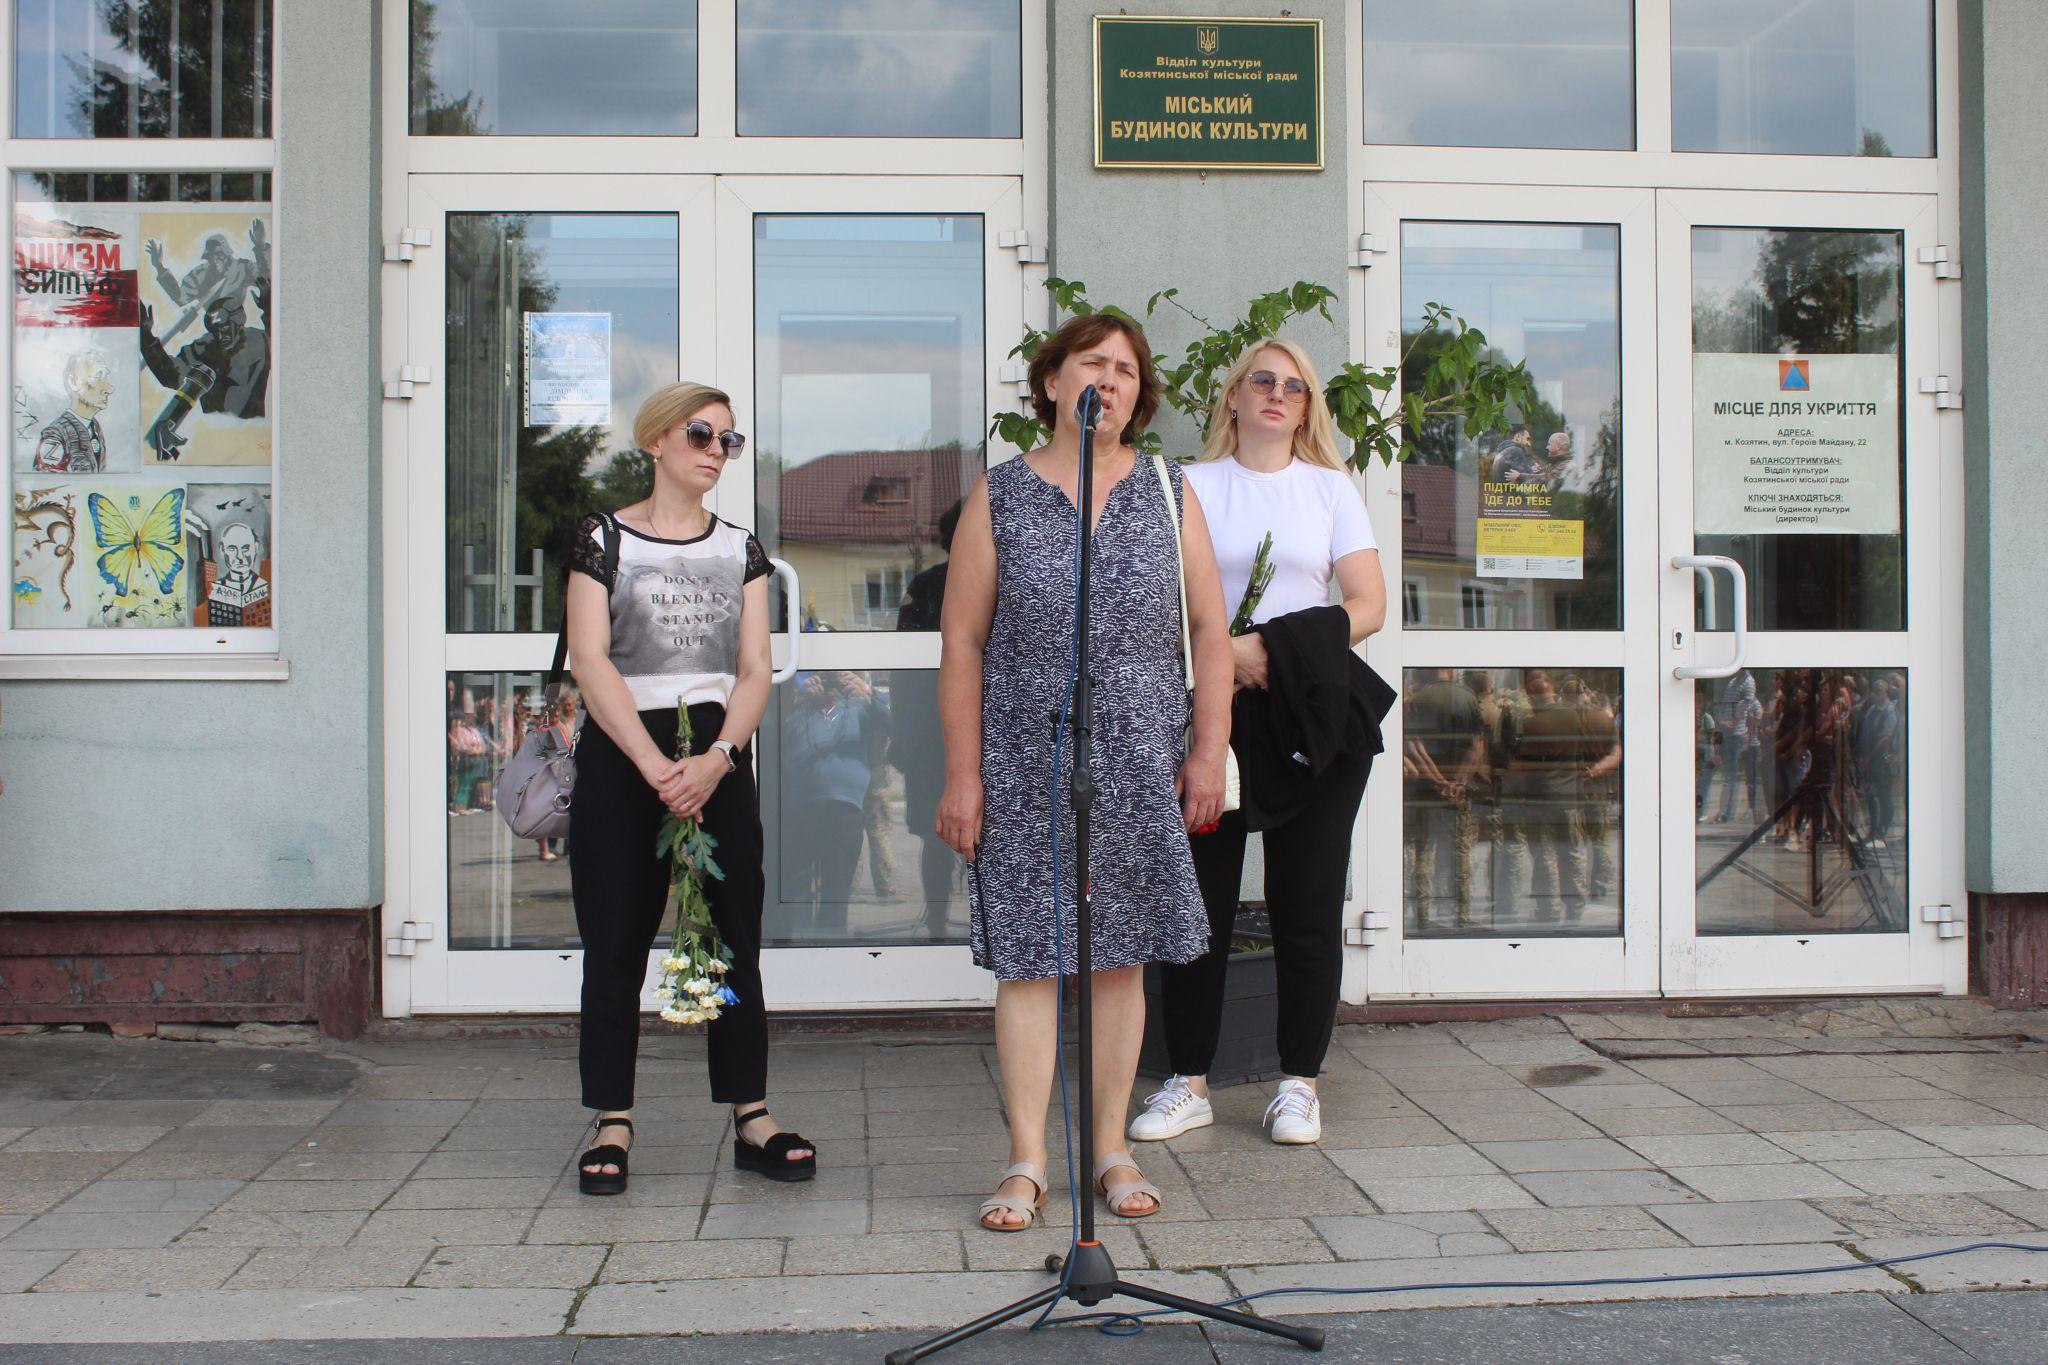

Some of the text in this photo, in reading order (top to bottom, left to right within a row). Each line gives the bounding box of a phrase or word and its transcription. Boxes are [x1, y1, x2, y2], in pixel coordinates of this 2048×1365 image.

[1156, 57, 1261, 69] Відділ культури
[1120, 69, 1298, 83] Козятинської міської ради
[1165, 93, 1253, 114] МІСЬКИЙ
[1110, 121, 1308, 142] БУДИНОК КУЛЬТУРИ
[1713, 402, 1877, 417] МІСЦЕ ДЛЯ УКРИТТЯ
[1777, 429, 1815, 437] АДРЕСА:
[1735, 438, 1771, 447] Козятин,
[1791, 438, 1817, 446] Героїв
[1819, 438, 1856, 447] Майдану,
[1858, 438, 1867, 446] 22
[1750, 457, 1843, 465] БАЛАНСОУТРИМУВАЧ:
[1764, 467, 1829, 476] Відділ культури
[1743, 476, 1850, 485] Козятинської міської ради
[1484, 482, 1548, 494] ПІДТРИМКА
[1484, 494, 1552, 507] ЇДЕ ДО ТЕБЕ
[1748, 494, 1844, 502] КЛЮЧІ ЗНАХОДЯТЬСЯ:
[1743, 505, 1850, 514] Міський будинок культури
[1775, 515, 1819, 523] (директор)
[664, 575, 712, 586] DON'T
[651, 592, 729, 605] BLEND IN
[662, 614, 715, 625] STAND
[673, 635, 707, 647] OUT
